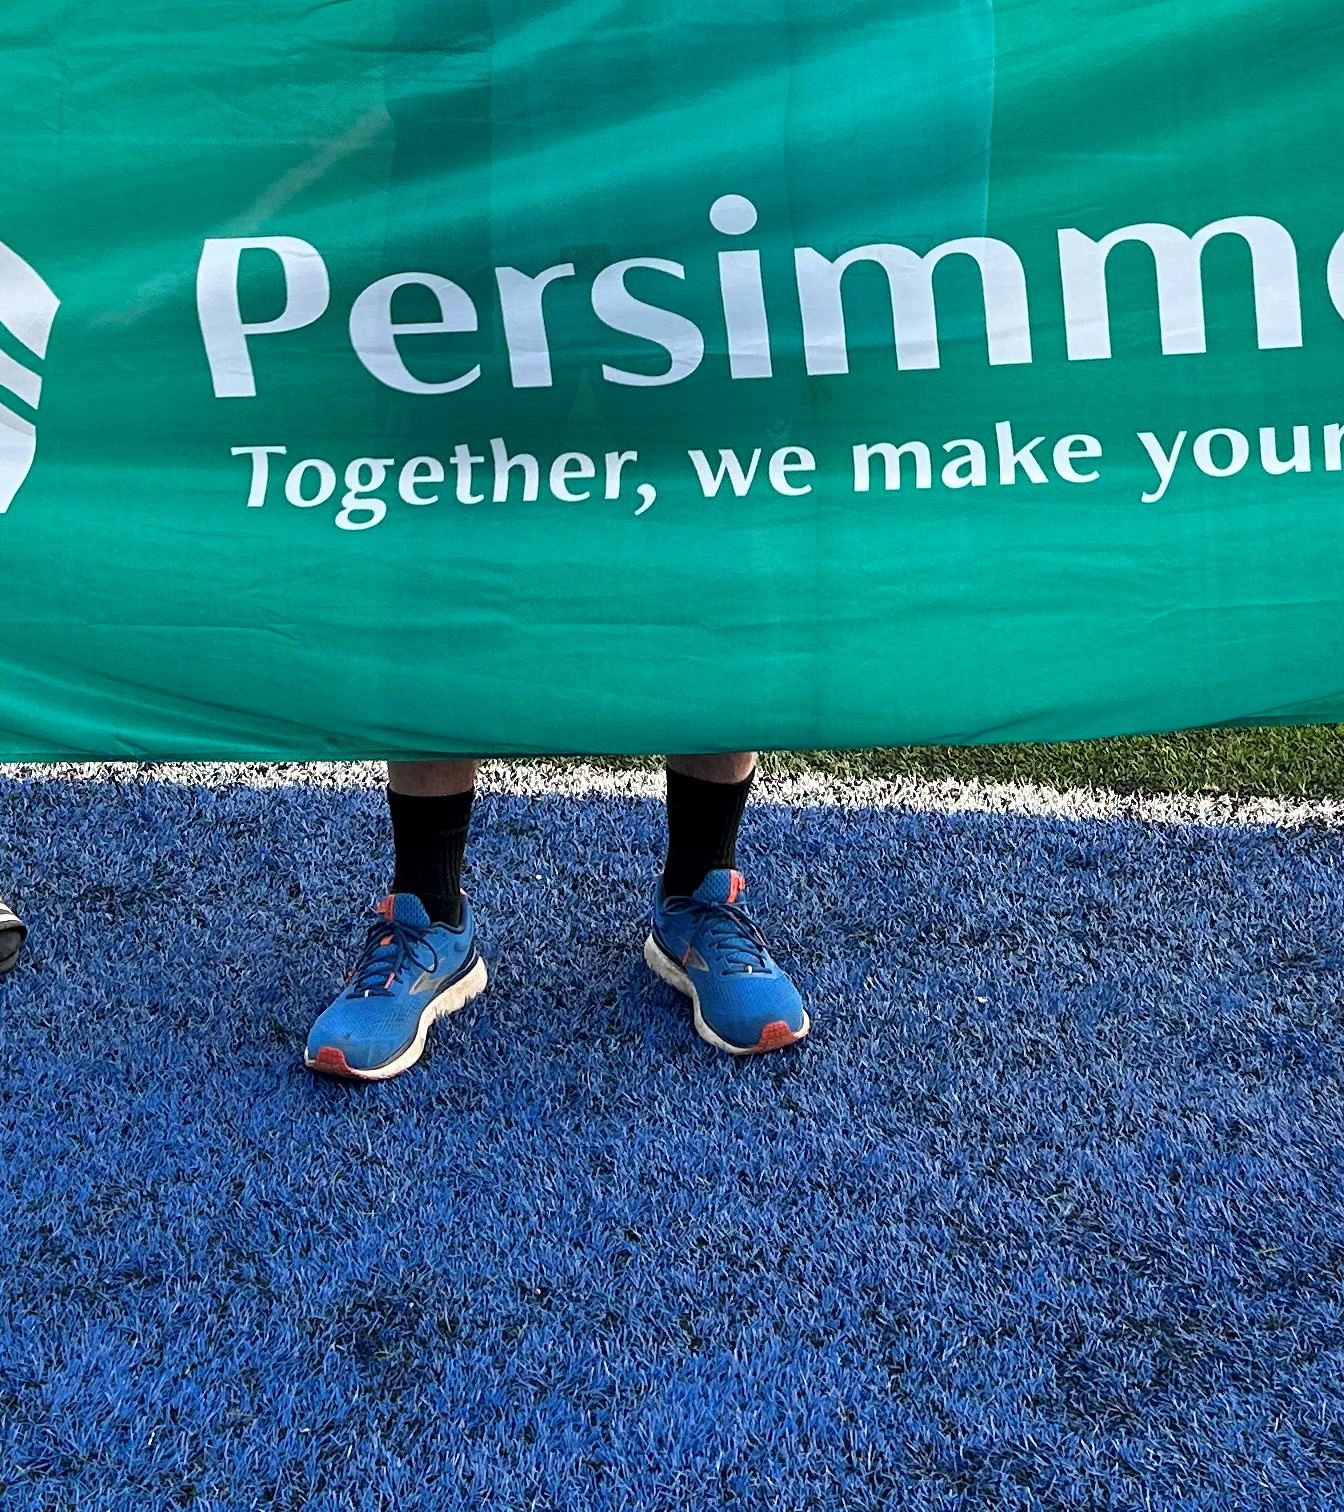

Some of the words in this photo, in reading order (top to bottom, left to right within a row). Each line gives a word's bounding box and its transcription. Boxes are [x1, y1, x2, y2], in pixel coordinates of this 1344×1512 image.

[232, 438, 656, 530] Together,
[688, 447, 815, 496] we
[853, 422, 1101, 491] make
